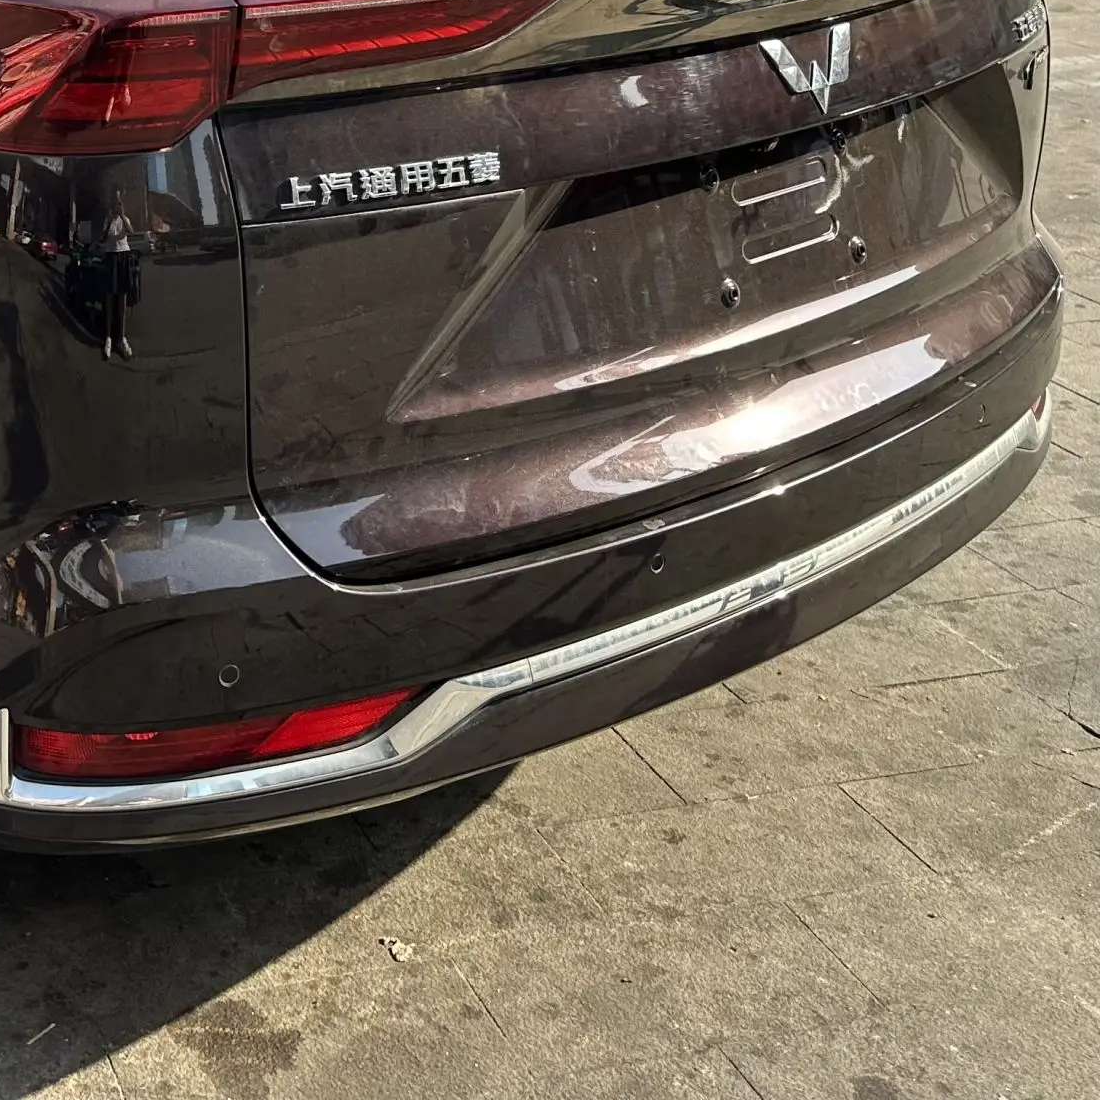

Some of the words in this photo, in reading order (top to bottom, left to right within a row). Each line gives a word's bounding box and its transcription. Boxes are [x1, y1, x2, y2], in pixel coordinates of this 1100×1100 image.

[280, 151, 500, 210] 上汽通用五菱
